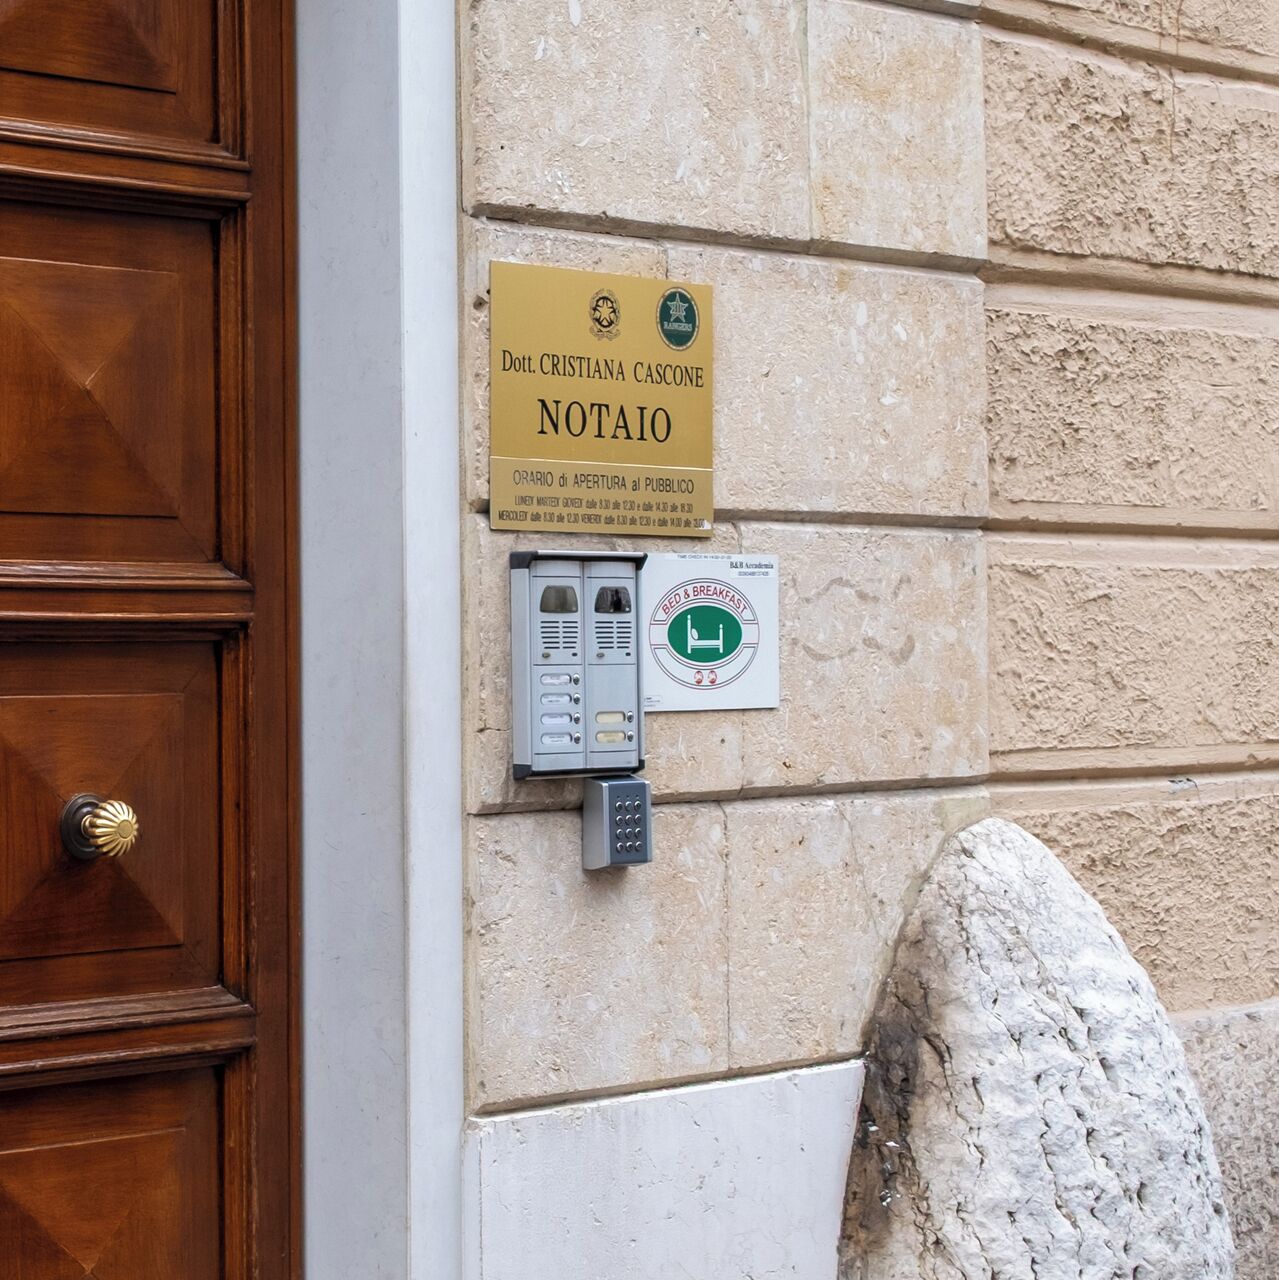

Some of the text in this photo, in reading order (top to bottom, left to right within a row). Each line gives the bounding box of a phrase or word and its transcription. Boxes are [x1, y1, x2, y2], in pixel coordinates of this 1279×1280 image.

[501, 349, 704, 388] Dott. CRISTIANA CASCONE
[537, 398, 672, 443] NOTAIO
[513, 469, 695, 494] ORARIO di APERTURA al PUBBLICO
[729, 561, 774, 570] B&B Accademia
[661, 585, 748, 615] BED & BREAKFAST
